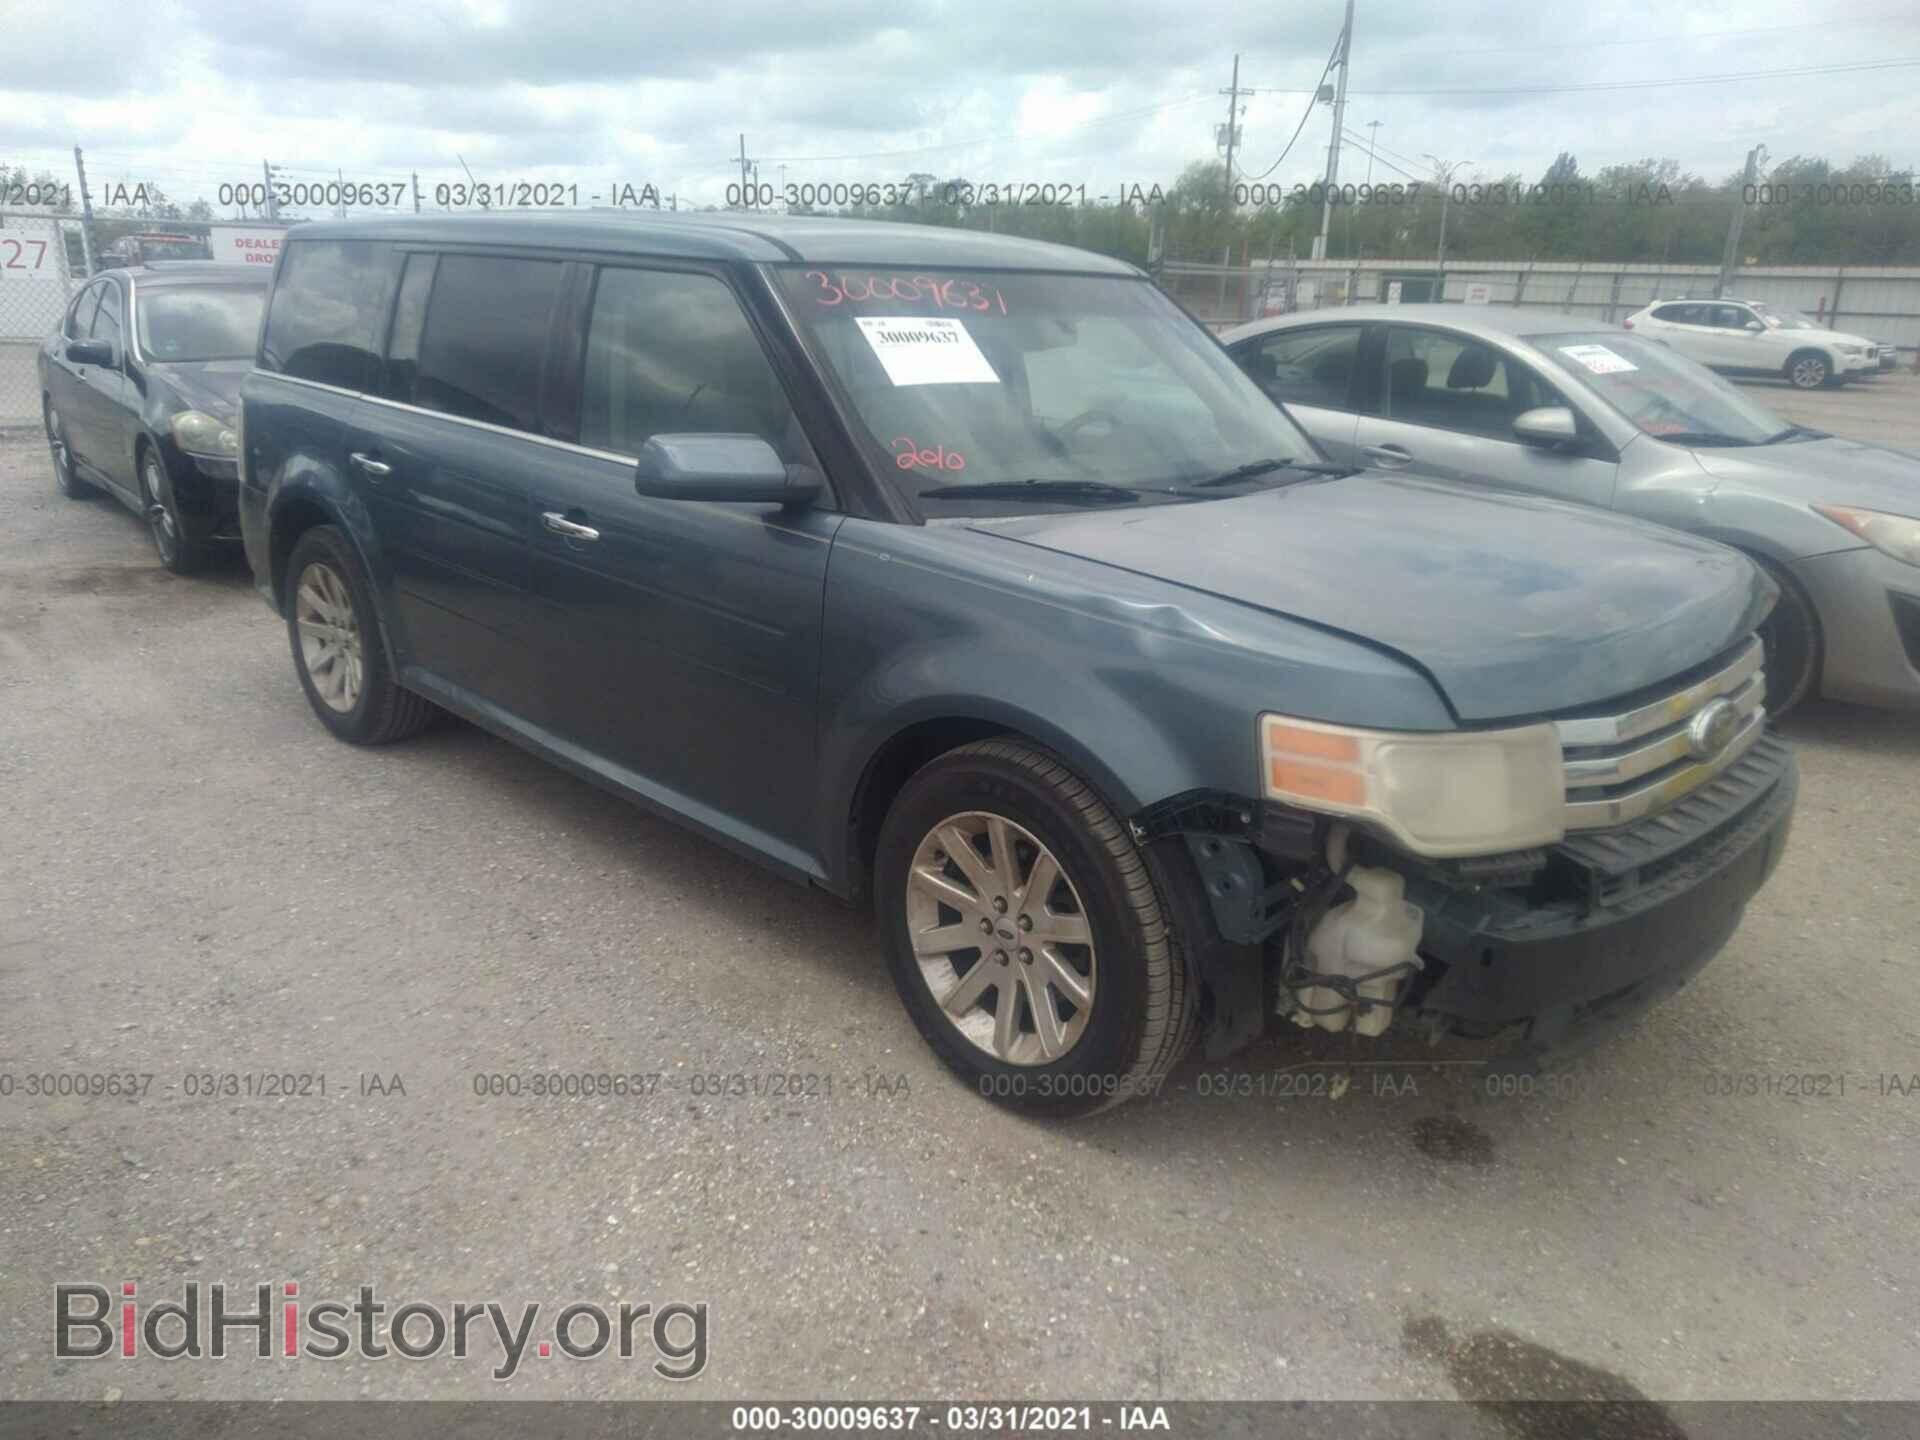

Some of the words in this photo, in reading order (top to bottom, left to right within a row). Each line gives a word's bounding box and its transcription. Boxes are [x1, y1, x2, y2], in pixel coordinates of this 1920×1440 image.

[235, 238, 281, 249] DEALE
[0, 238, 48, 270] 27
[245, 253, 276, 264] DRO
[876, 330, 960, 344] 30009637
